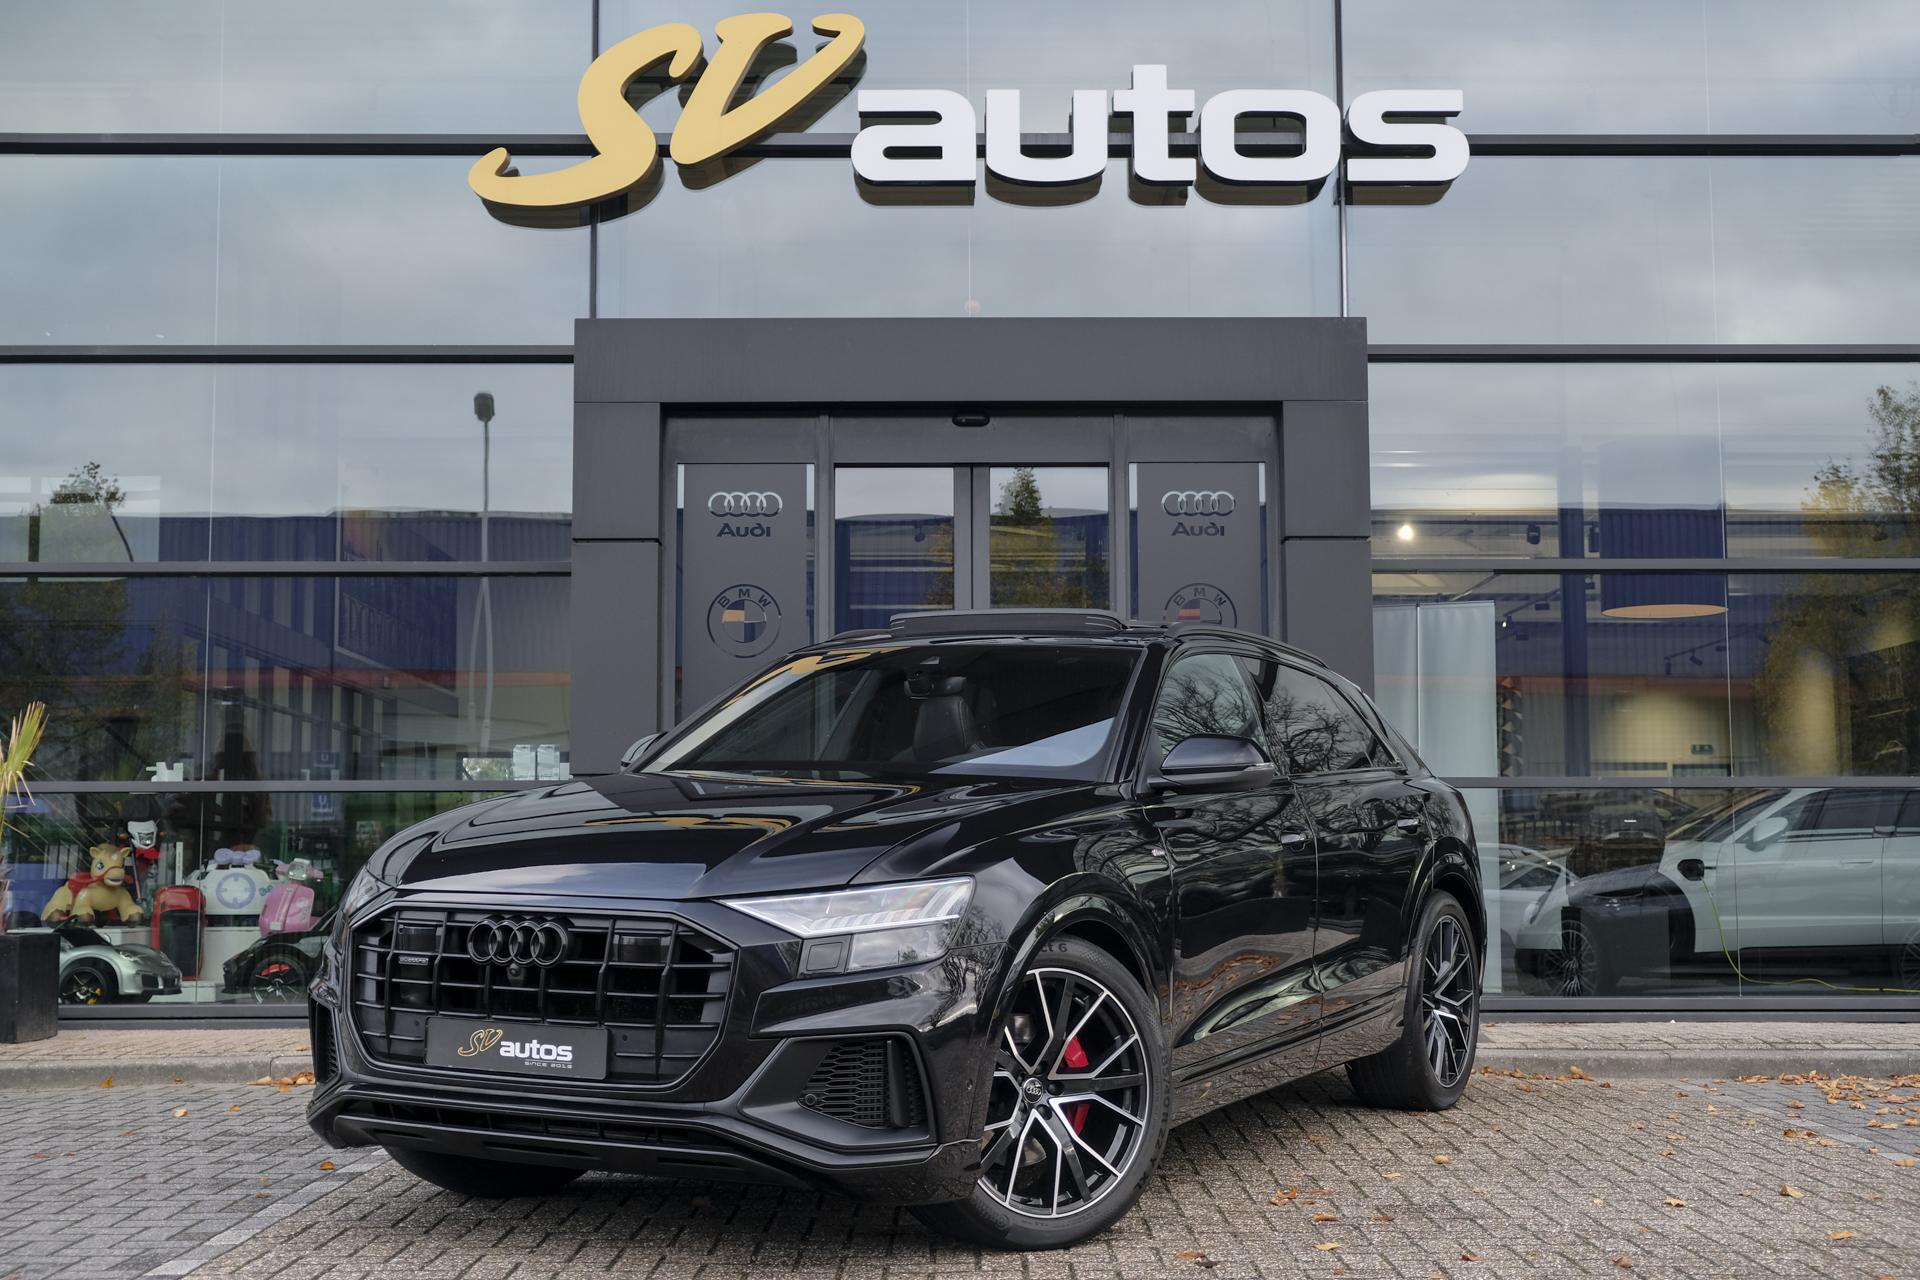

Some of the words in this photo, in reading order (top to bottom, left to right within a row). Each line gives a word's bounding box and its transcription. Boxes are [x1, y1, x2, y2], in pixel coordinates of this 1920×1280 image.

[850, 63, 1470, 187] autos
[716, 522, 771, 538] Audi
[1170, 521, 1225, 537] Audi
[717, 588, 773, 609] BMW
[1172, 586, 1228, 607] BMW
[1058, 942, 1068, 953] 6
[499, 1039, 573, 1062] autos
